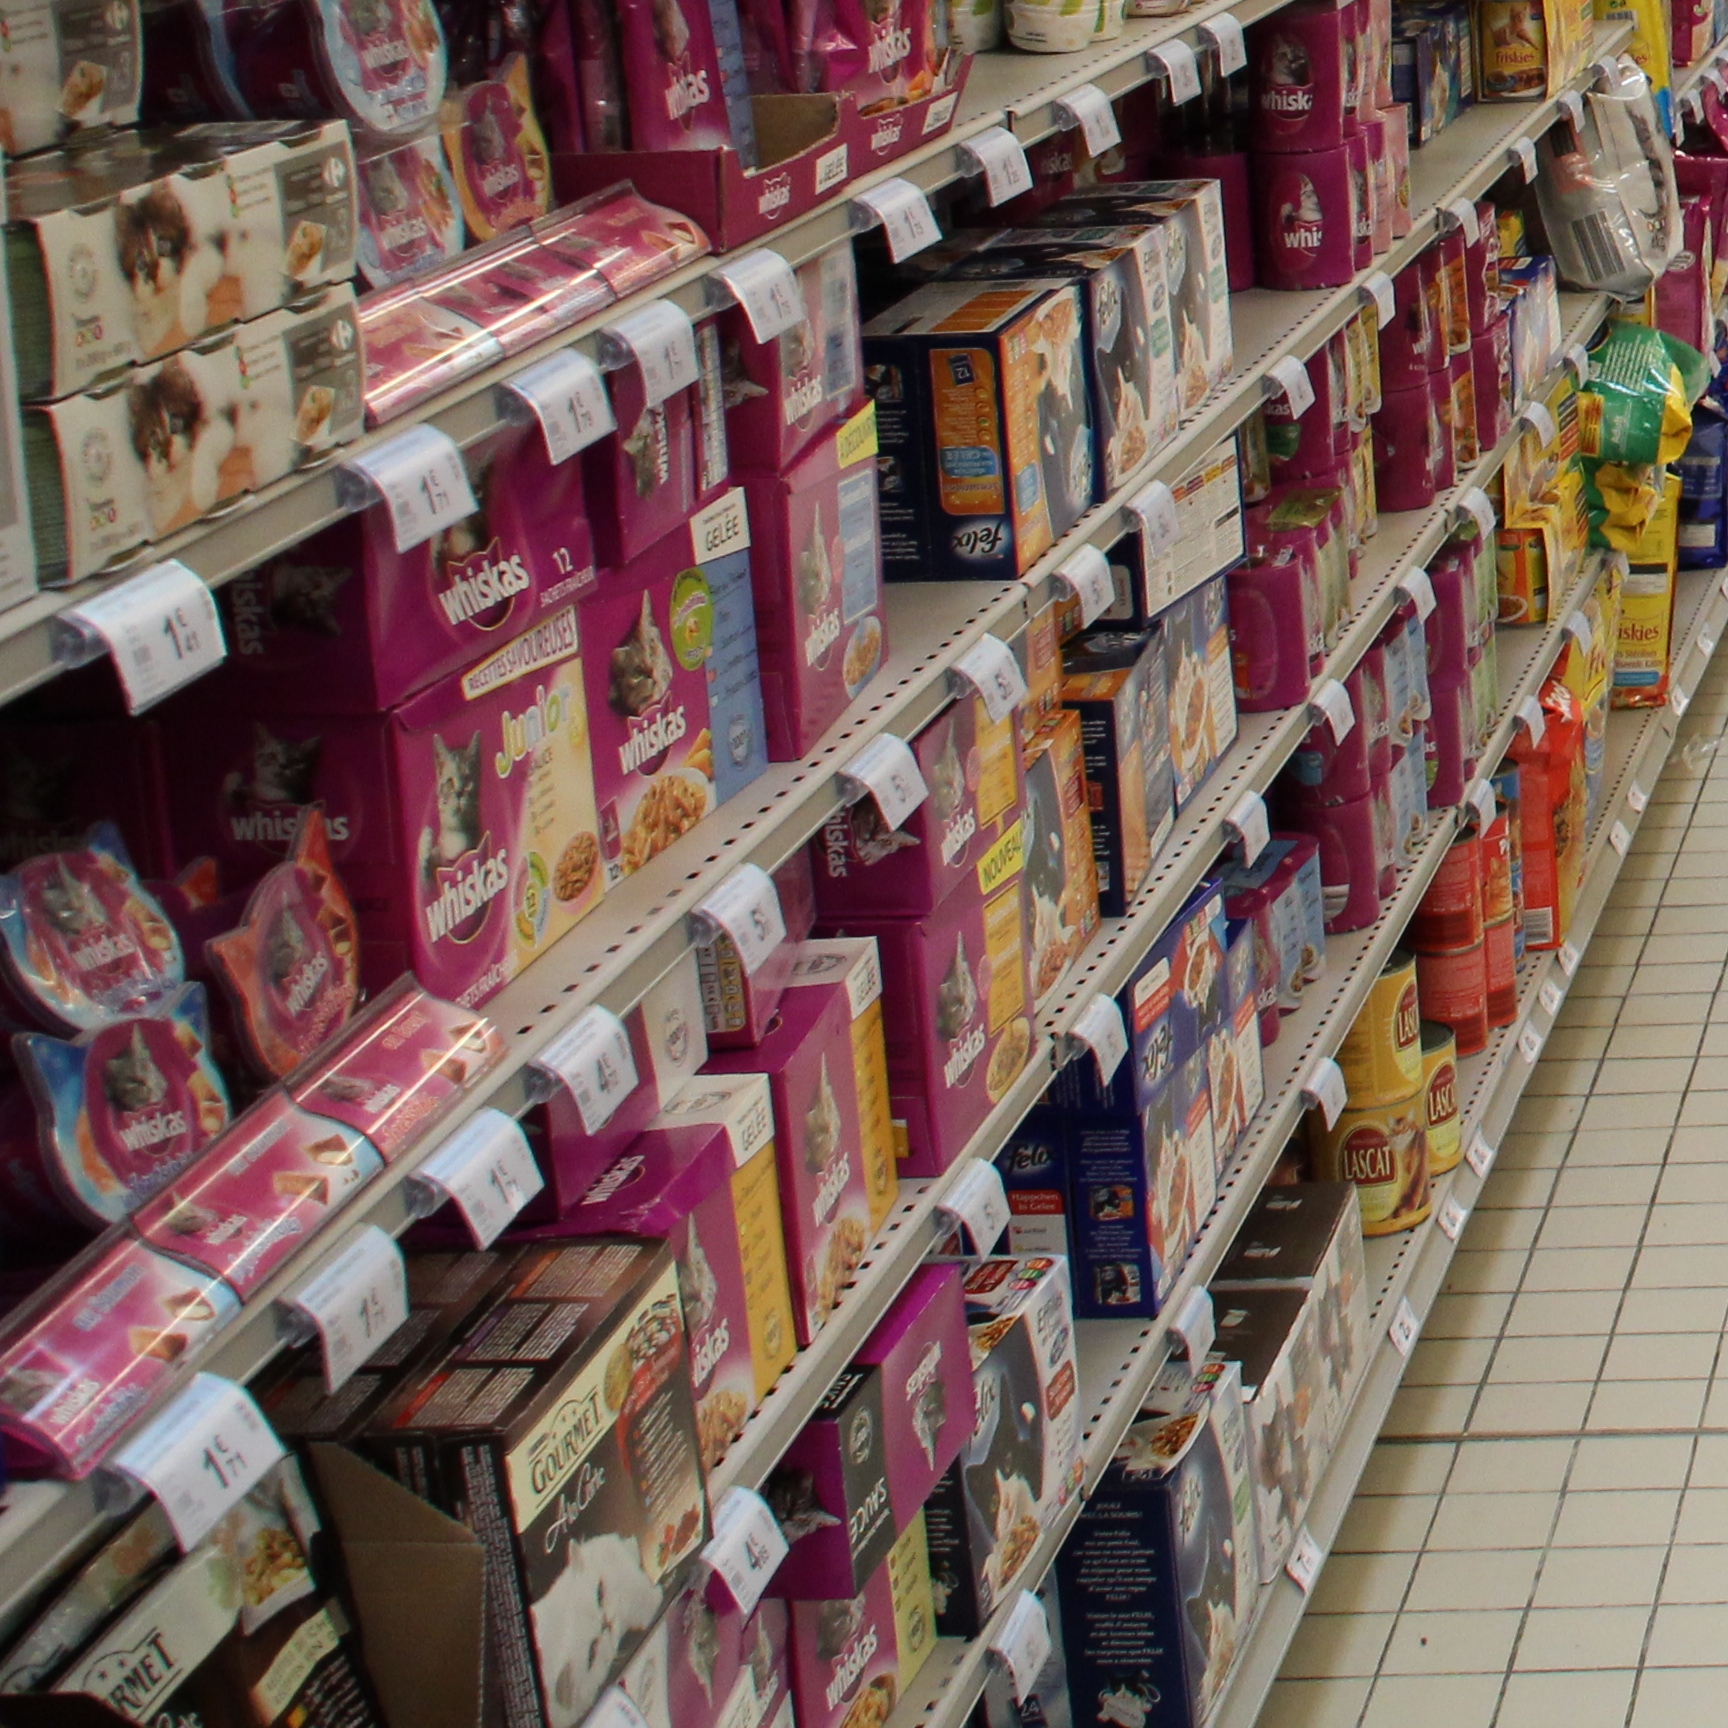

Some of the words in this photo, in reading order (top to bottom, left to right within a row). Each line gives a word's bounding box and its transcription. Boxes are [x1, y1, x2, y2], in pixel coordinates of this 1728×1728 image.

[867, 24, 912, 74] whiskas
[756, 177, 792, 214] whiskas
[784, 372, 823, 430] whiskas
[553, 547, 574, 574] 12
[704, 514, 741, 553] GELÉE
[438, 554, 531, 626] whiskas
[466, 655, 507, 690] RECETTES
[504, 612, 575, 674] SAVOUREUSES
[805, 609, 841, 669] whiskas
[495, 683, 571, 780] Junior
[618, 705, 688, 775] whiskas
[940, 805, 977, 868] whiskas
[425, 847, 509, 943] whiskas
[71, 930, 136, 972] whiskas
[943, 1020, 986, 1091] whiskas
[117, 1108, 189, 1151] whiskas
[1006, 1140, 1055, 1171] felix
[812, 1151, 851, 1224] whiskas
[1343, 1145, 1393, 1181] LASCAT
[530, 1390, 605, 1497] GOURMET
[849, 1475, 888, 1538] SAUCE
[825, 1623, 880, 1713] whiskas
